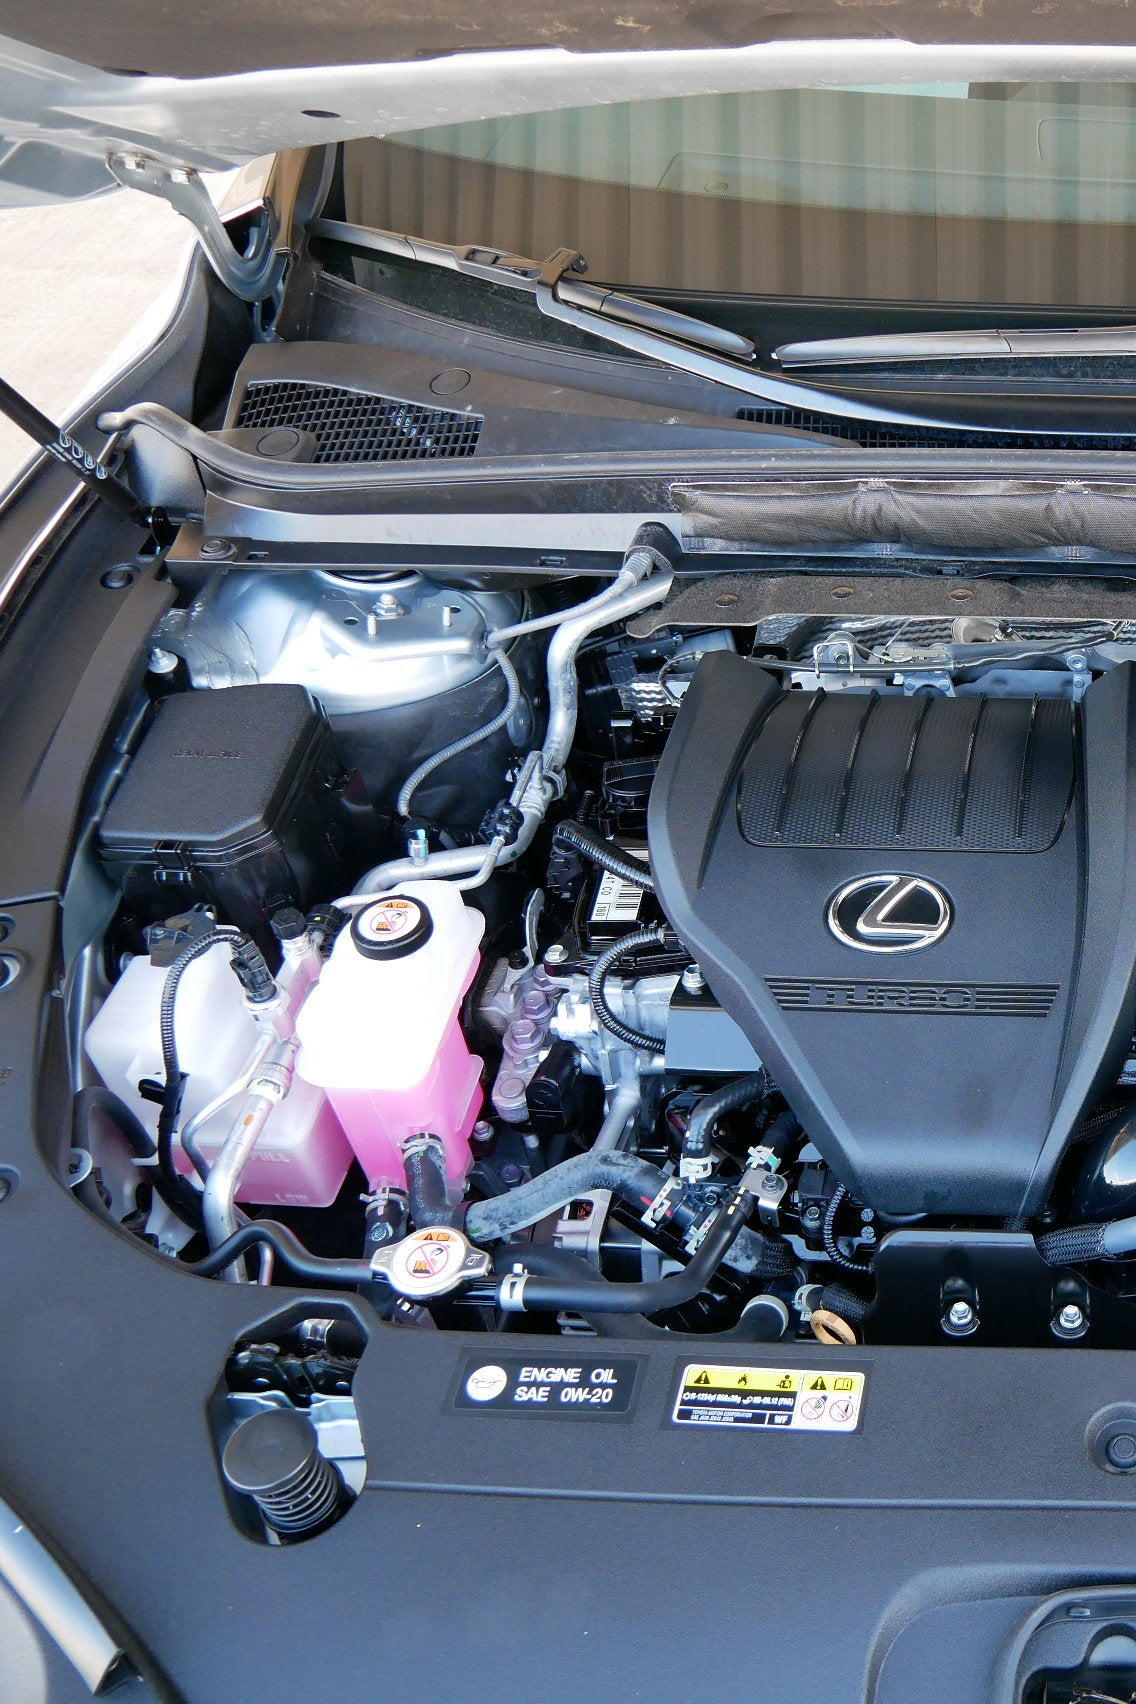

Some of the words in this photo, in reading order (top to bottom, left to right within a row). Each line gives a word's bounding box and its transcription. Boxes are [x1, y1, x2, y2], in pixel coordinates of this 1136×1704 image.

[813, 984, 972, 1009] TURBO
[518, 1366, 583, 1384] ENGINE
[590, 1367, 618, 1384] OIL
[513, 1385, 551, 1403] SAE
[559, 1386, 614, 1404] 0W-20
[774, 1414, 789, 1425] WF
